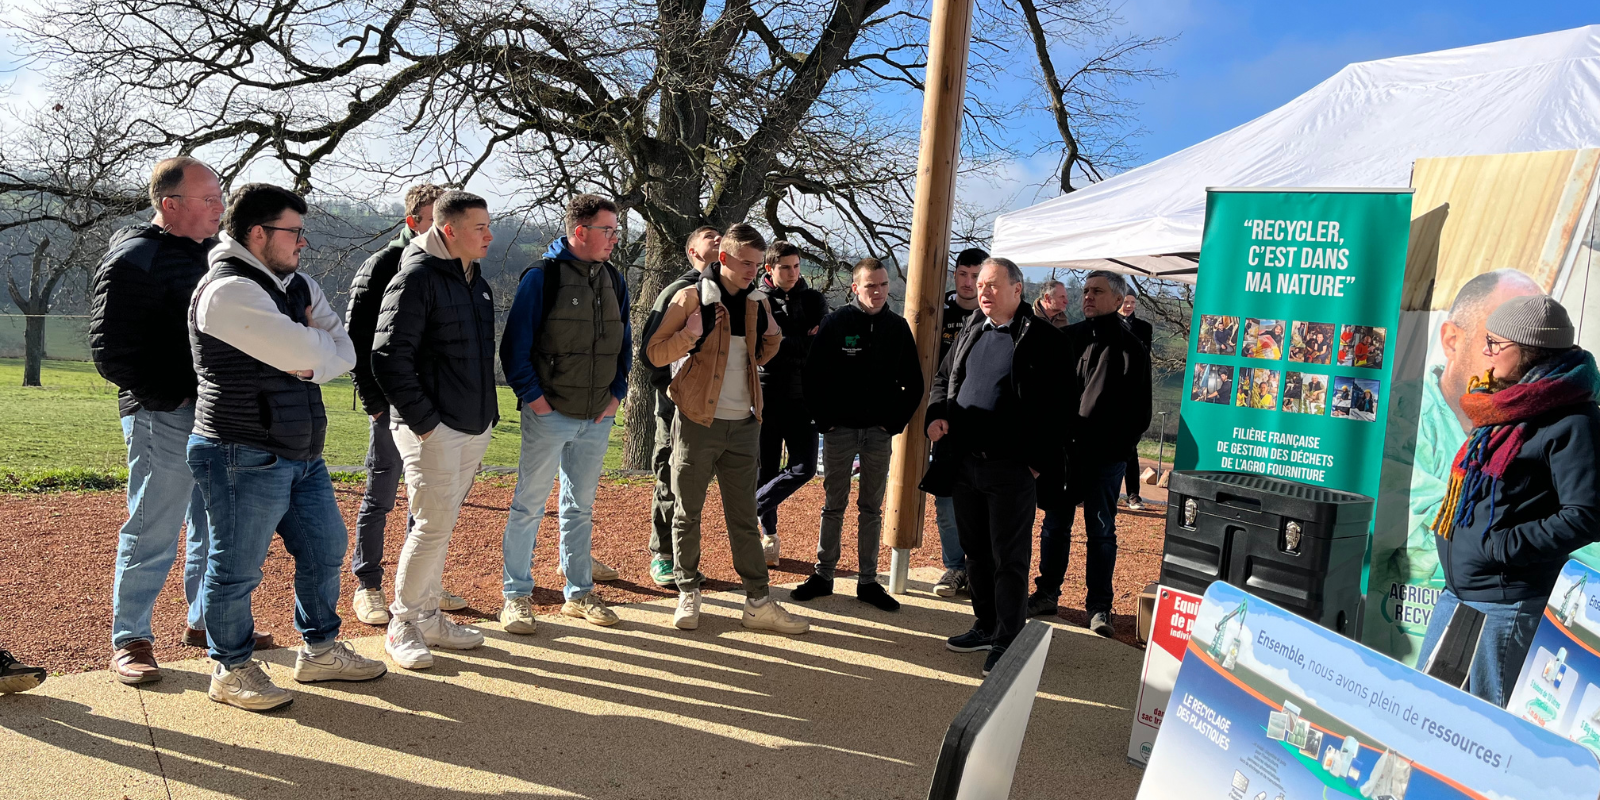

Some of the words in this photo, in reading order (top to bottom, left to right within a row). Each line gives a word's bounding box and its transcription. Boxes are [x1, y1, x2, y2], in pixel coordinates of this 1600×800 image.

[1243, 219, 1345, 246] “RECYCLER,
[1248, 245, 1298, 268] C’EST
[1300, 247, 1350, 270] DANS
[1245, 271, 1272, 293] MA
[1276, 273, 1356, 297] NATURE”
[1232, 426, 1267, 442] FILIÈRE
[1268, 431, 1321, 449] FRANÇAISE
[1216, 440, 1230, 453] DE
[1230, 442, 1269, 459] GESTION
[1270, 447, 1289, 461] DES
[1290, 449, 1334, 467] DÉCHETS
[1221, 456, 1233, 469] DE
[1235, 458, 1266, 474] L’AGRO
[1266, 462, 1326, 482] FOURNITURE
[1173, 596, 1200, 616] Equi
[1394, 604, 1432, 625] RECY
[1170, 612, 1186, 629] de
[1170, 627, 1192, 641] indivi
[1182, 692, 1194, 708] LE
[1191, 698, 1232, 734] RECYCLAGE
[1257, 629, 1306, 670] Ensemble,
[1308, 659, 1334, 681] nous
[1335, 673, 1369, 699] avons
[1369, 690, 1401, 716] plein
[1402, 705, 1419, 725] de
[1421, 717, 1502, 768] ressources
[1504, 754, 1513, 774] !
[1141, 713, 1153, 722] sac
[1176, 704, 1191, 723] DES
[1189, 713, 1231, 751] PLASTIQUES
